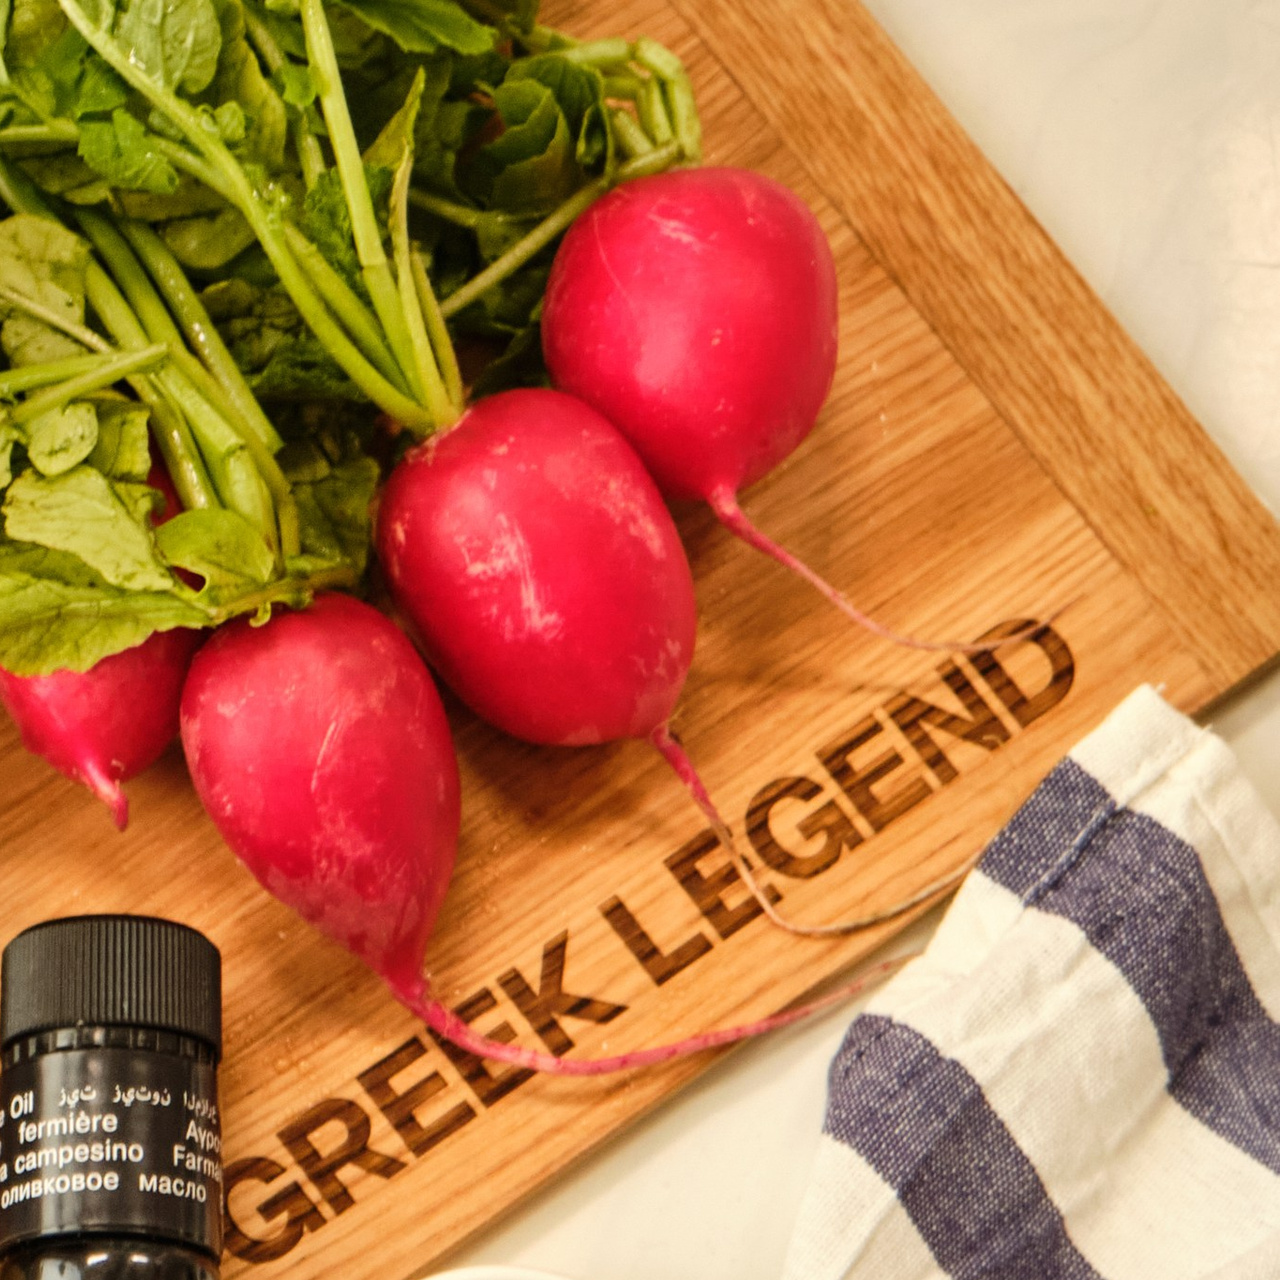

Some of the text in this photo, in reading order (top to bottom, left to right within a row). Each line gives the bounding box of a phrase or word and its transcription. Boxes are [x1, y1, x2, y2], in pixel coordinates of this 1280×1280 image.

[223, 618, 1076, 1264] GREEK LEGEND
[10, 1090, 34, 1119] Oil
[19, 1111, 118, 1144] fermière
[186, 1119, 220, 1153] Αγρο
[14, 1139, 144, 1174] campesino
[173, 1144, 221, 1183] Farmá
[1, 1172, 119, 1209] оливковое
[139, 1173, 207, 1203] масло
